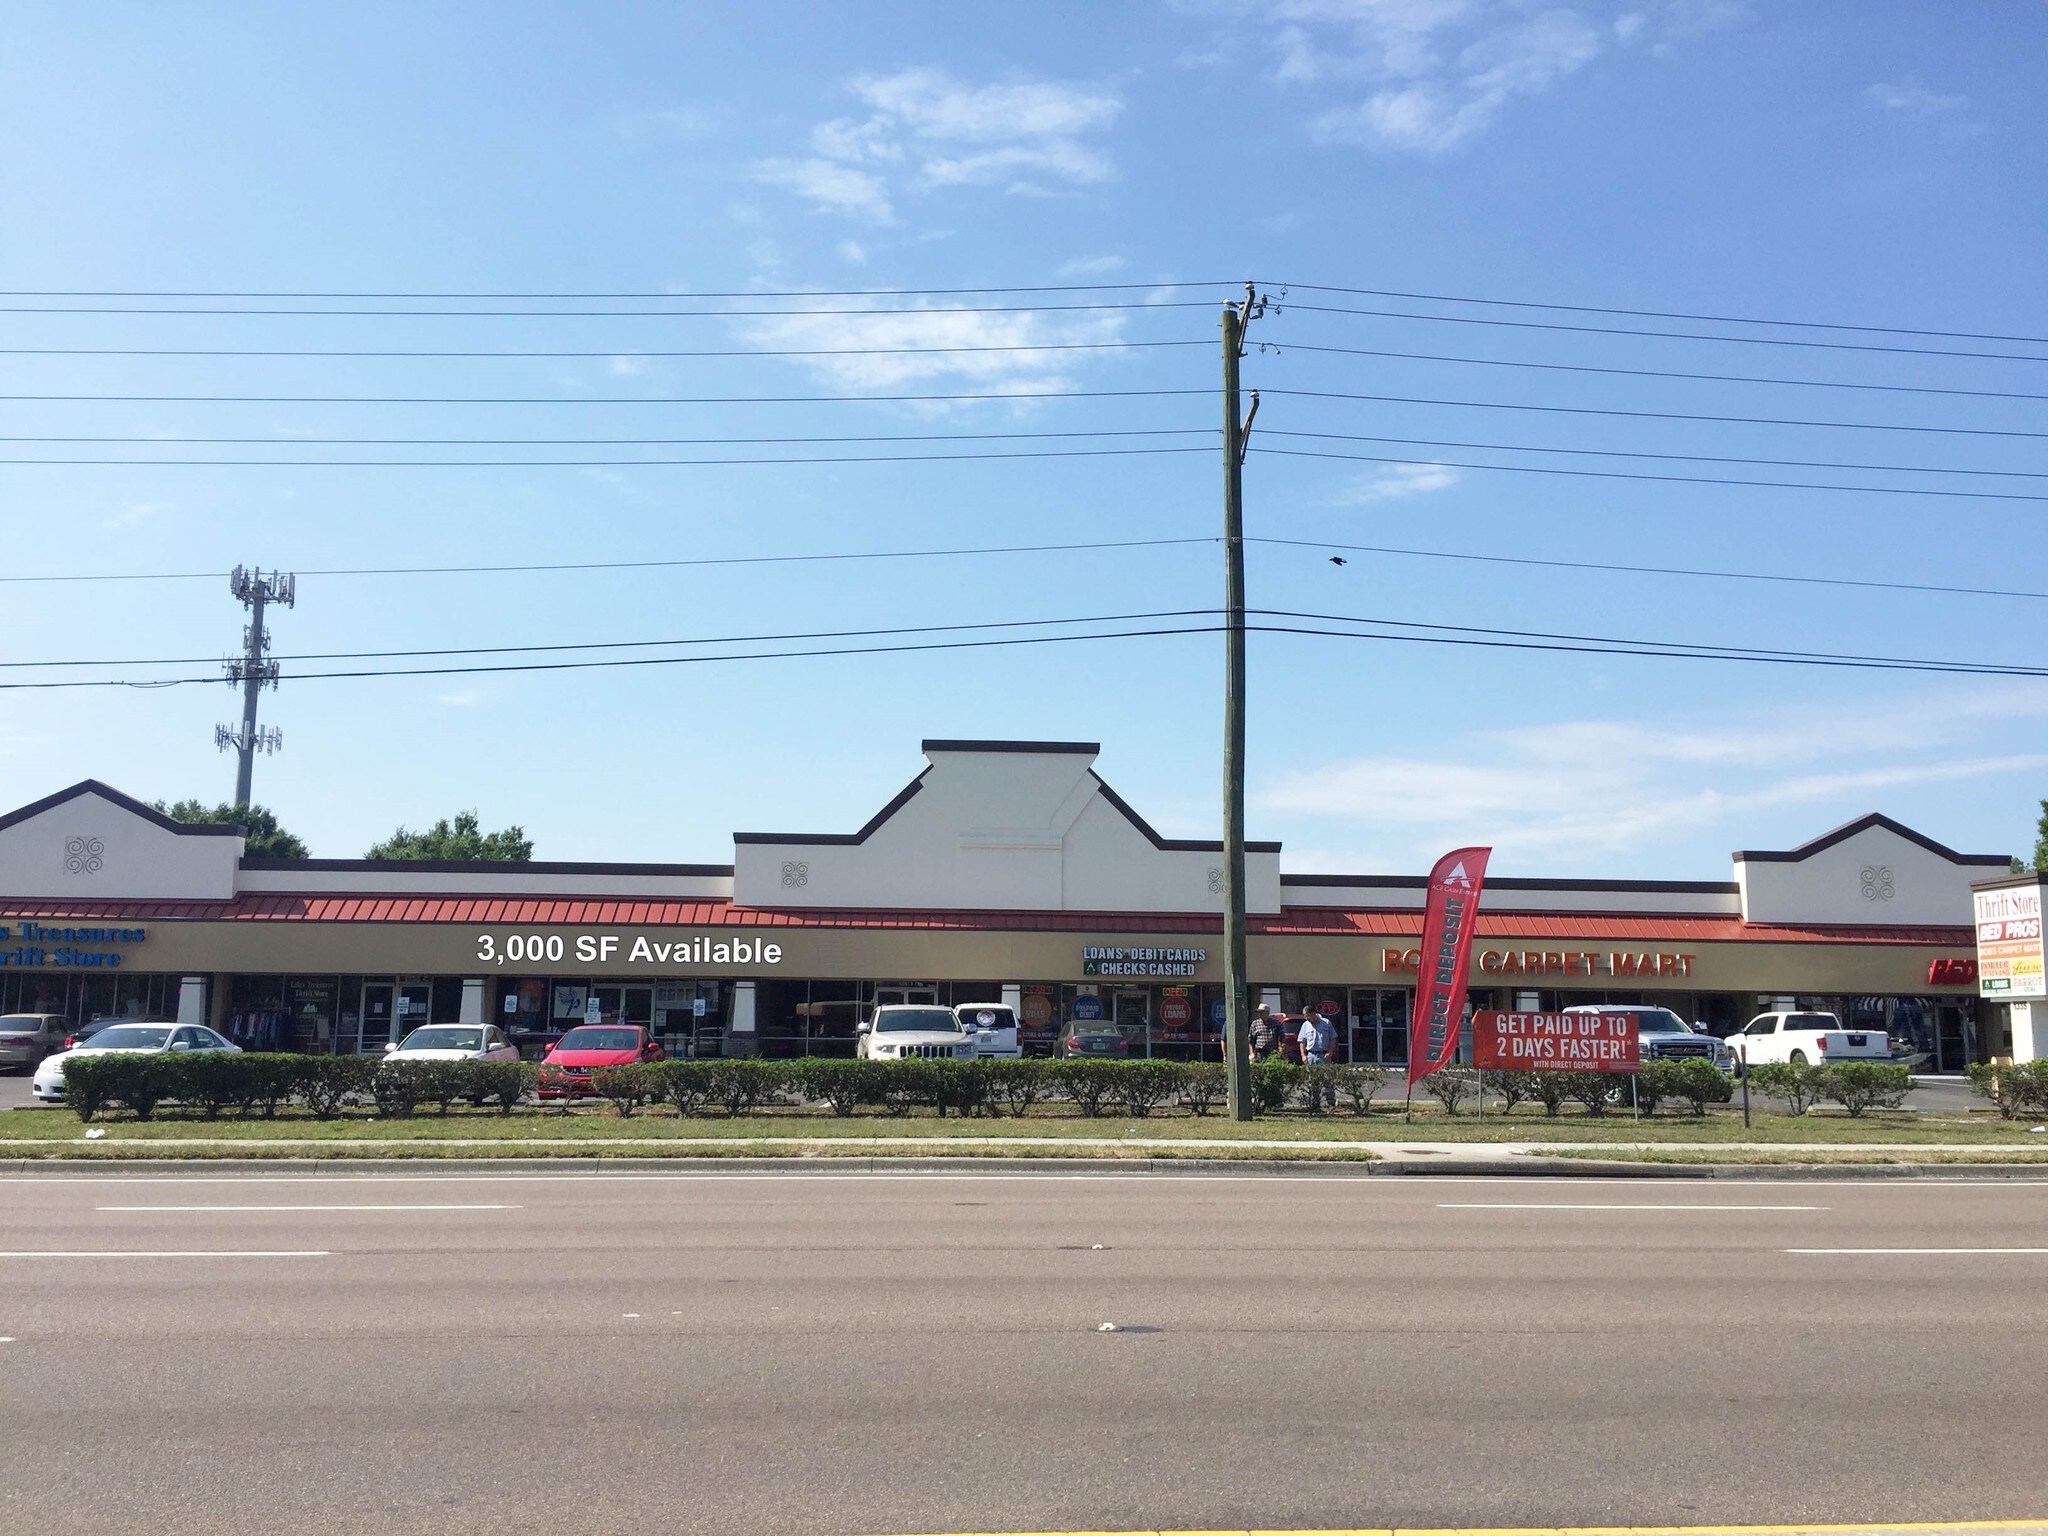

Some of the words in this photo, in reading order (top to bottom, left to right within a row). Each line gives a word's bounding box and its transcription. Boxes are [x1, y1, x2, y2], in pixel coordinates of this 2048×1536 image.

[1977, 893, 2009, 918] Thrift
[2012, 890, 2039, 915] Store
[17, 922, 145, 943] Treasures
[1979, 923, 2003, 941] BED
[2005, 919, 2039, 939] PROS
[1435, 897, 1464, 986] DEPOSIT
[54, 947, 122, 967] Store
[1083, 946, 1123, 960] LOANS
[1130, 947, 1166, 961] DEBIT
[1166, 948, 1206, 961] CARDS
[1480, 950, 1601, 976] CARPET
[1609, 952, 1697, 977] MART
[1100, 962, 1146, 975] CHECKS
[1149, 963, 1195, 976] CASHED
[1164, 1010, 1187, 1019] LOANS
[1425, 990, 1452, 1063] DIRECT
[1496, 1014, 1528, 1034] GET
[1533, 1015, 1573, 1035] PAID
[1578, 1017, 1602, 1036] UP
[1606, 1017, 1627, 1037] TO
[1497, 1037, 1507, 1057] 2
[1512, 1038, 1555, 1058] DAYS
[1533, 1060, 1549, 1069] WITH
[1550, 1061, 1573, 1069] DIRECT
[1573, 1061, 1599, 1070] DEPOSIT
